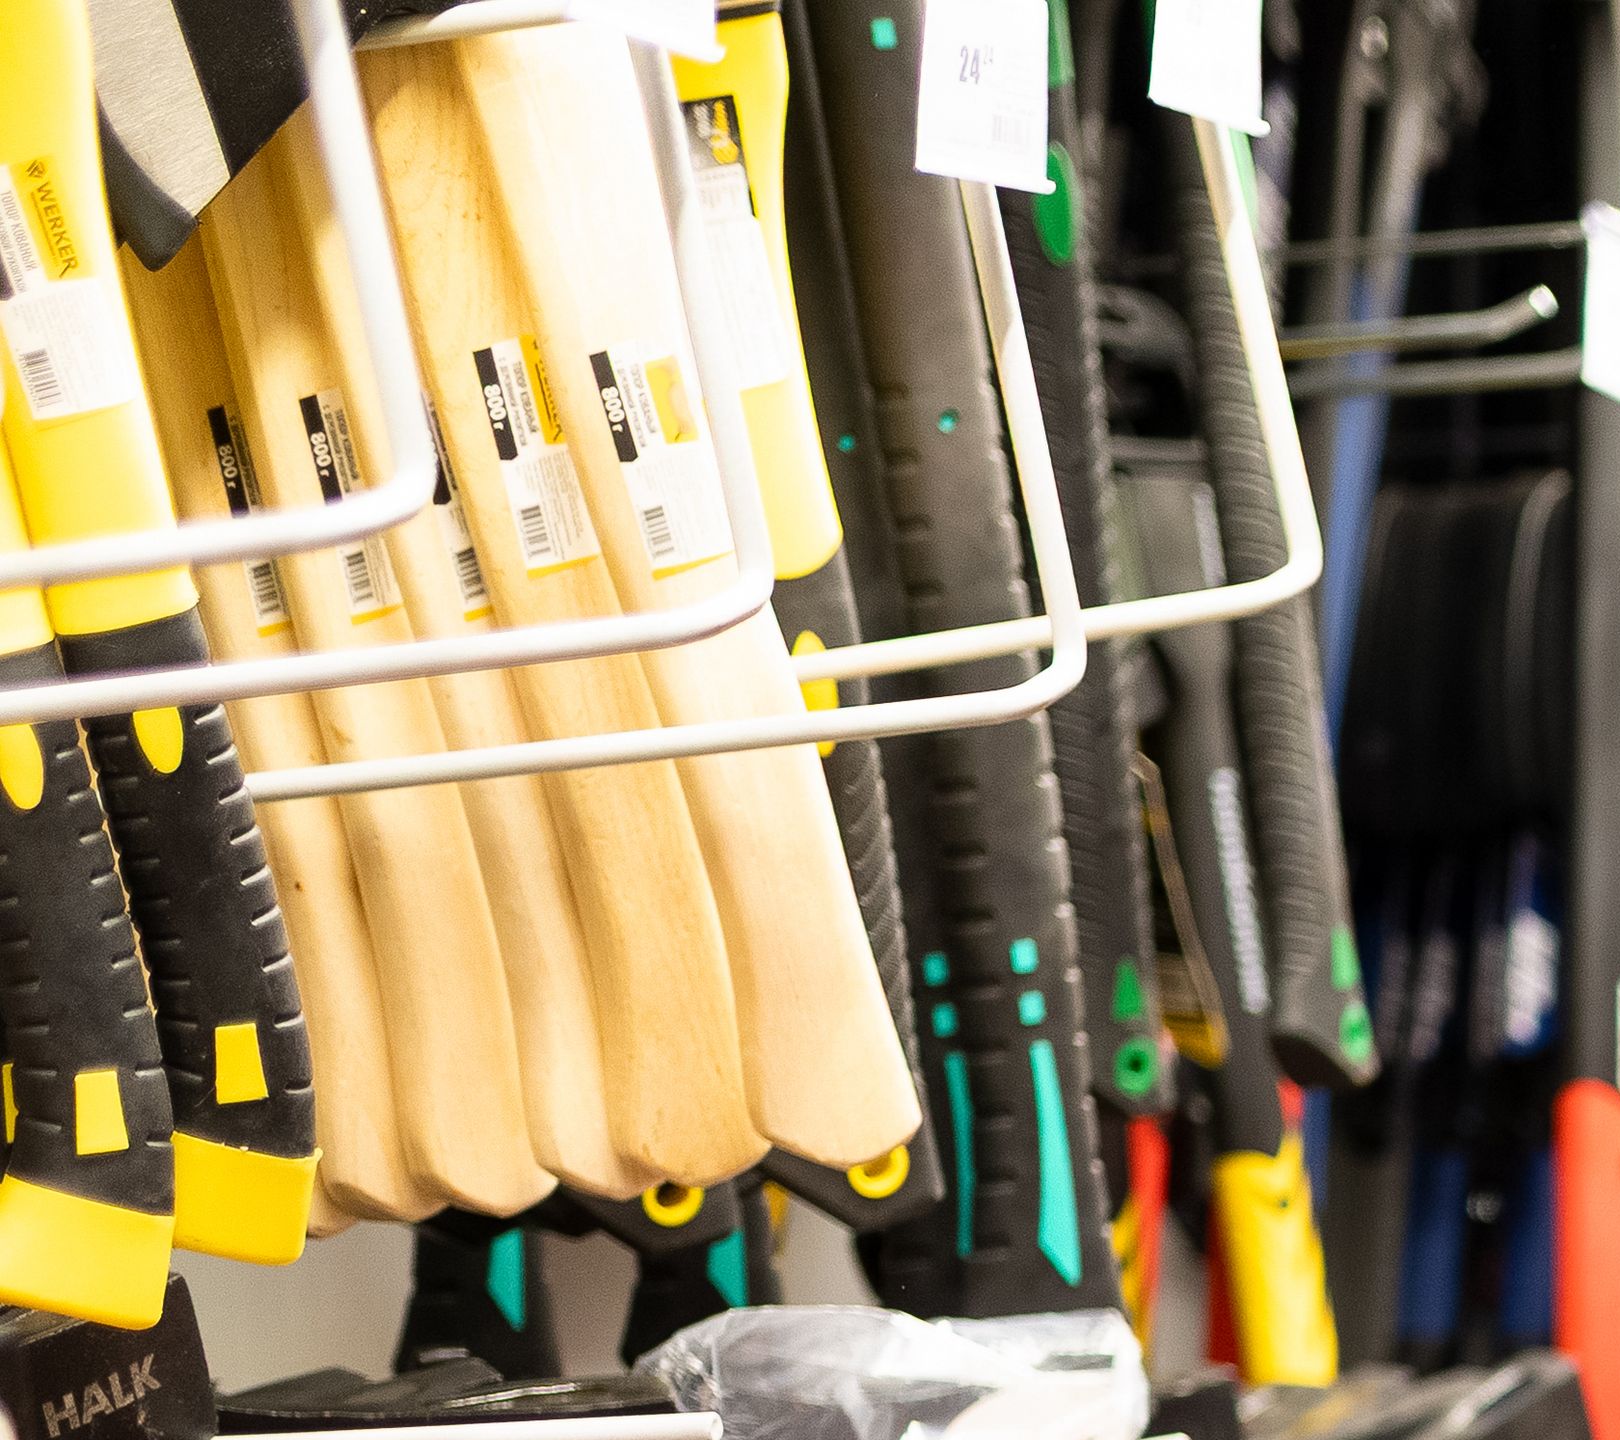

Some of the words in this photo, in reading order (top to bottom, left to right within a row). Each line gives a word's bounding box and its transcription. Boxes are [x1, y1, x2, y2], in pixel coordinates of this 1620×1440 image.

[37, 181, 78, 278] WERKER
[484, 383, 507, 422] 800
[601, 385, 625, 423] 800
[218, 444, 237, 479] 800
[310, 431, 332, 468] 800
[42, 1353, 162, 1438] HALK
